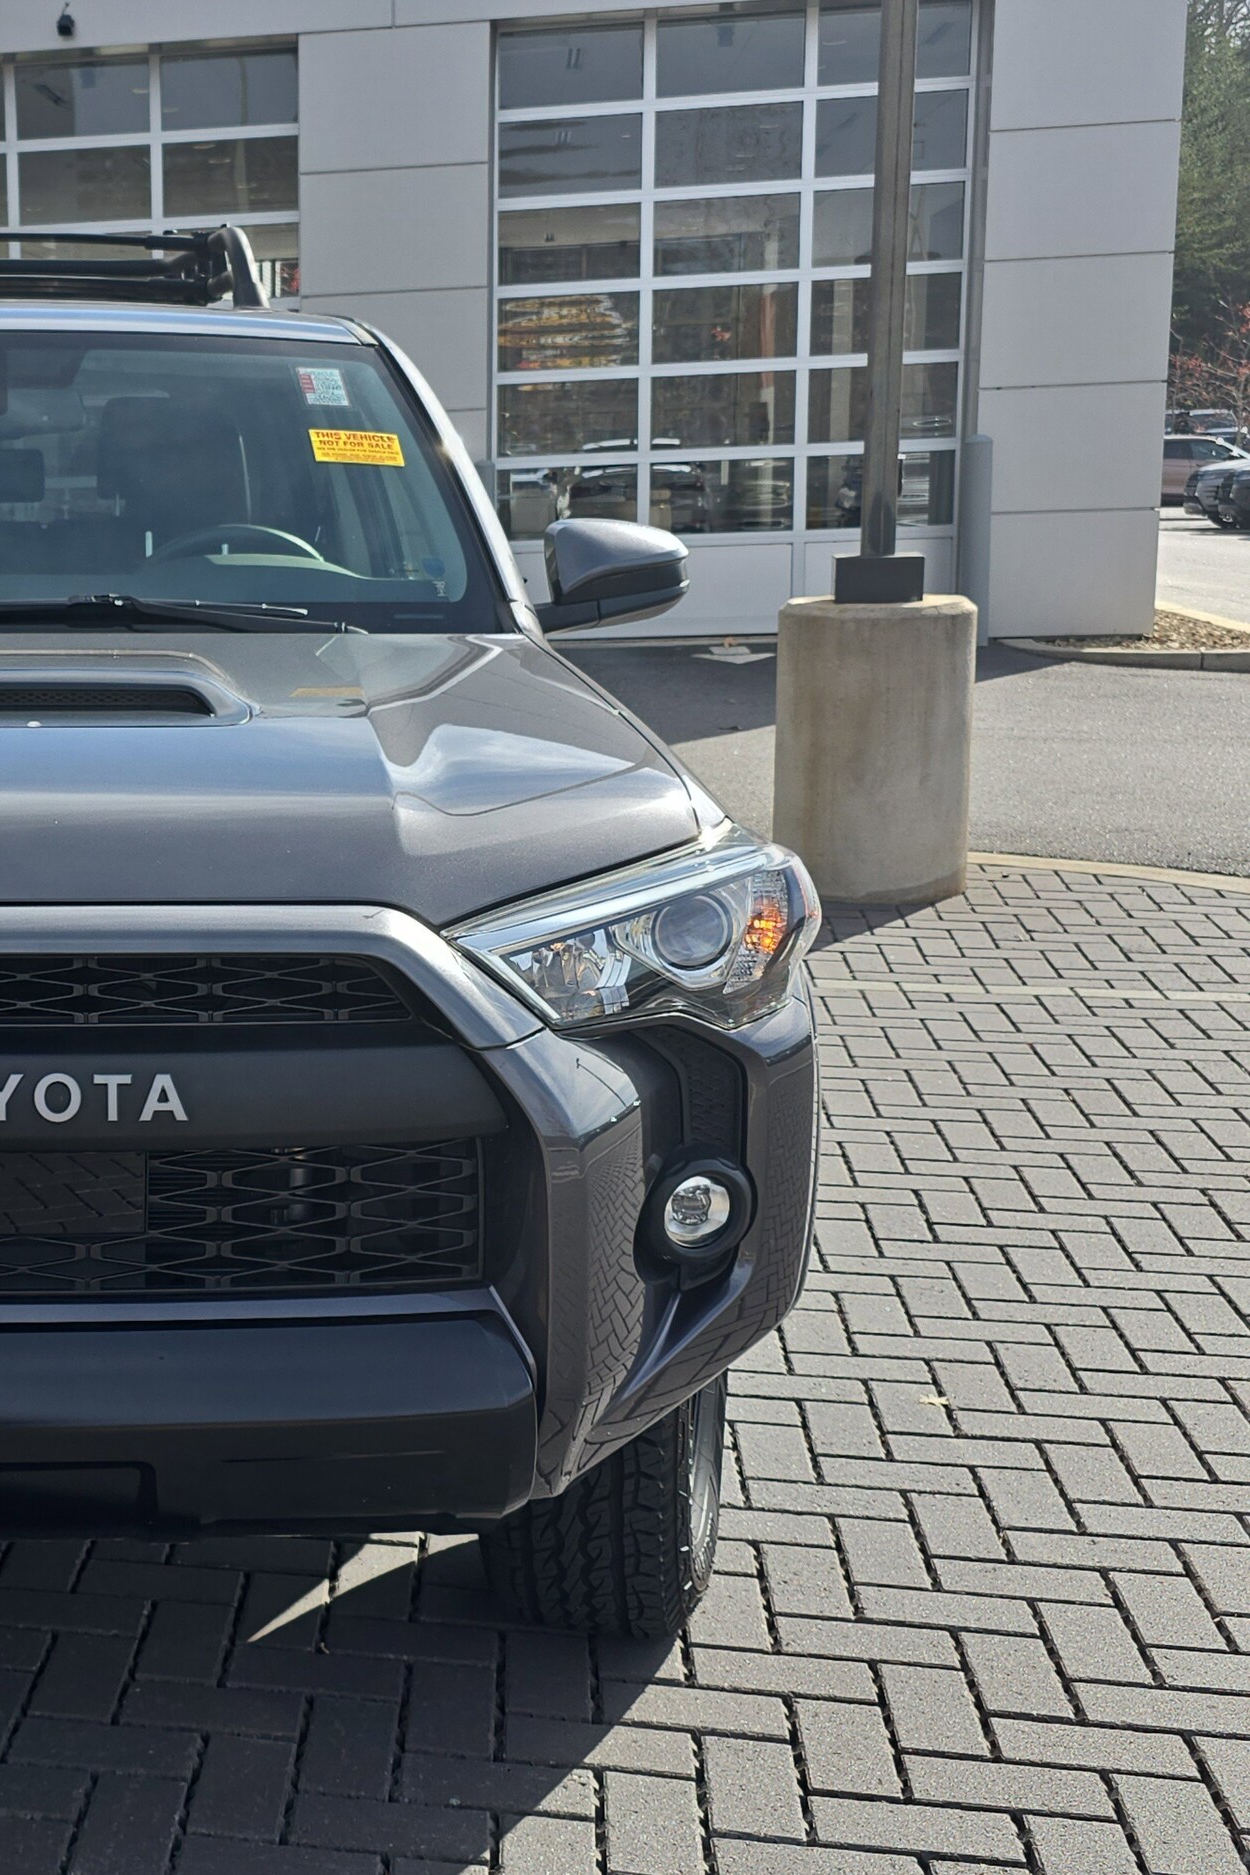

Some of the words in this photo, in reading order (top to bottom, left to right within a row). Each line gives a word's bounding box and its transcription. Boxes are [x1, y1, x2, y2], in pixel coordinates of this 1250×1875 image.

[315, 432, 342, 440] THIS
[344, 432, 395, 443] VEHICLE
[367, 442, 394, 450] SALE
